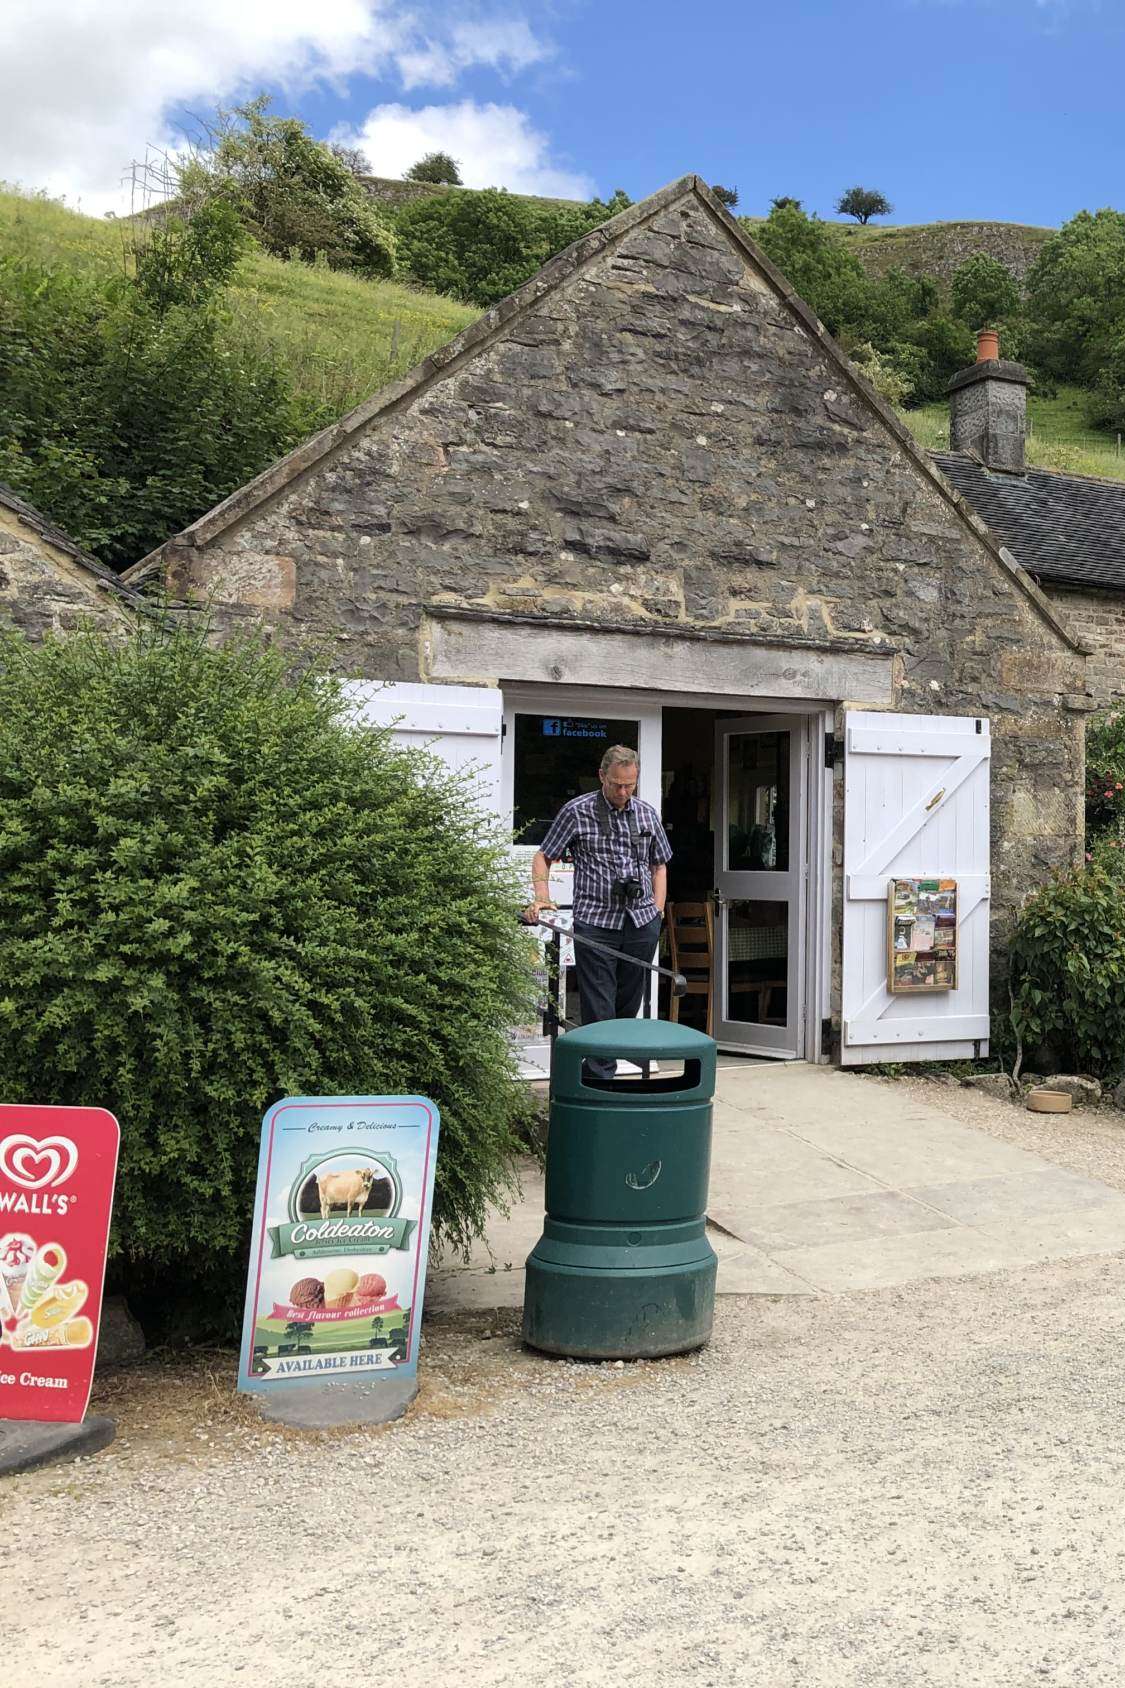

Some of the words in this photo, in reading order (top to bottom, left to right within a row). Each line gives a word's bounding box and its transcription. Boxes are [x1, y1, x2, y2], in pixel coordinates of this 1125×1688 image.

[563, 729, 607, 738] facebook
[307, 1121, 343, 1133] Creamy
[347, 1121, 354, 1130] &
[356, 1121, 397, 1130] Delicious
[0, 1191, 69, 1215] WALL'S
[290, 1219, 394, 1244] Coldeaton
[286, 1309, 304, 1319] Best
[306, 1310, 341, 1321] flavour
[344, 1303, 385, 1318] collection
[276, 1355, 348, 1374] AVAILABLE
[349, 1353, 383, 1367] HERE
[0, 1371, 16, 1385] ce
[19, 1372, 69, 1389] Cream
